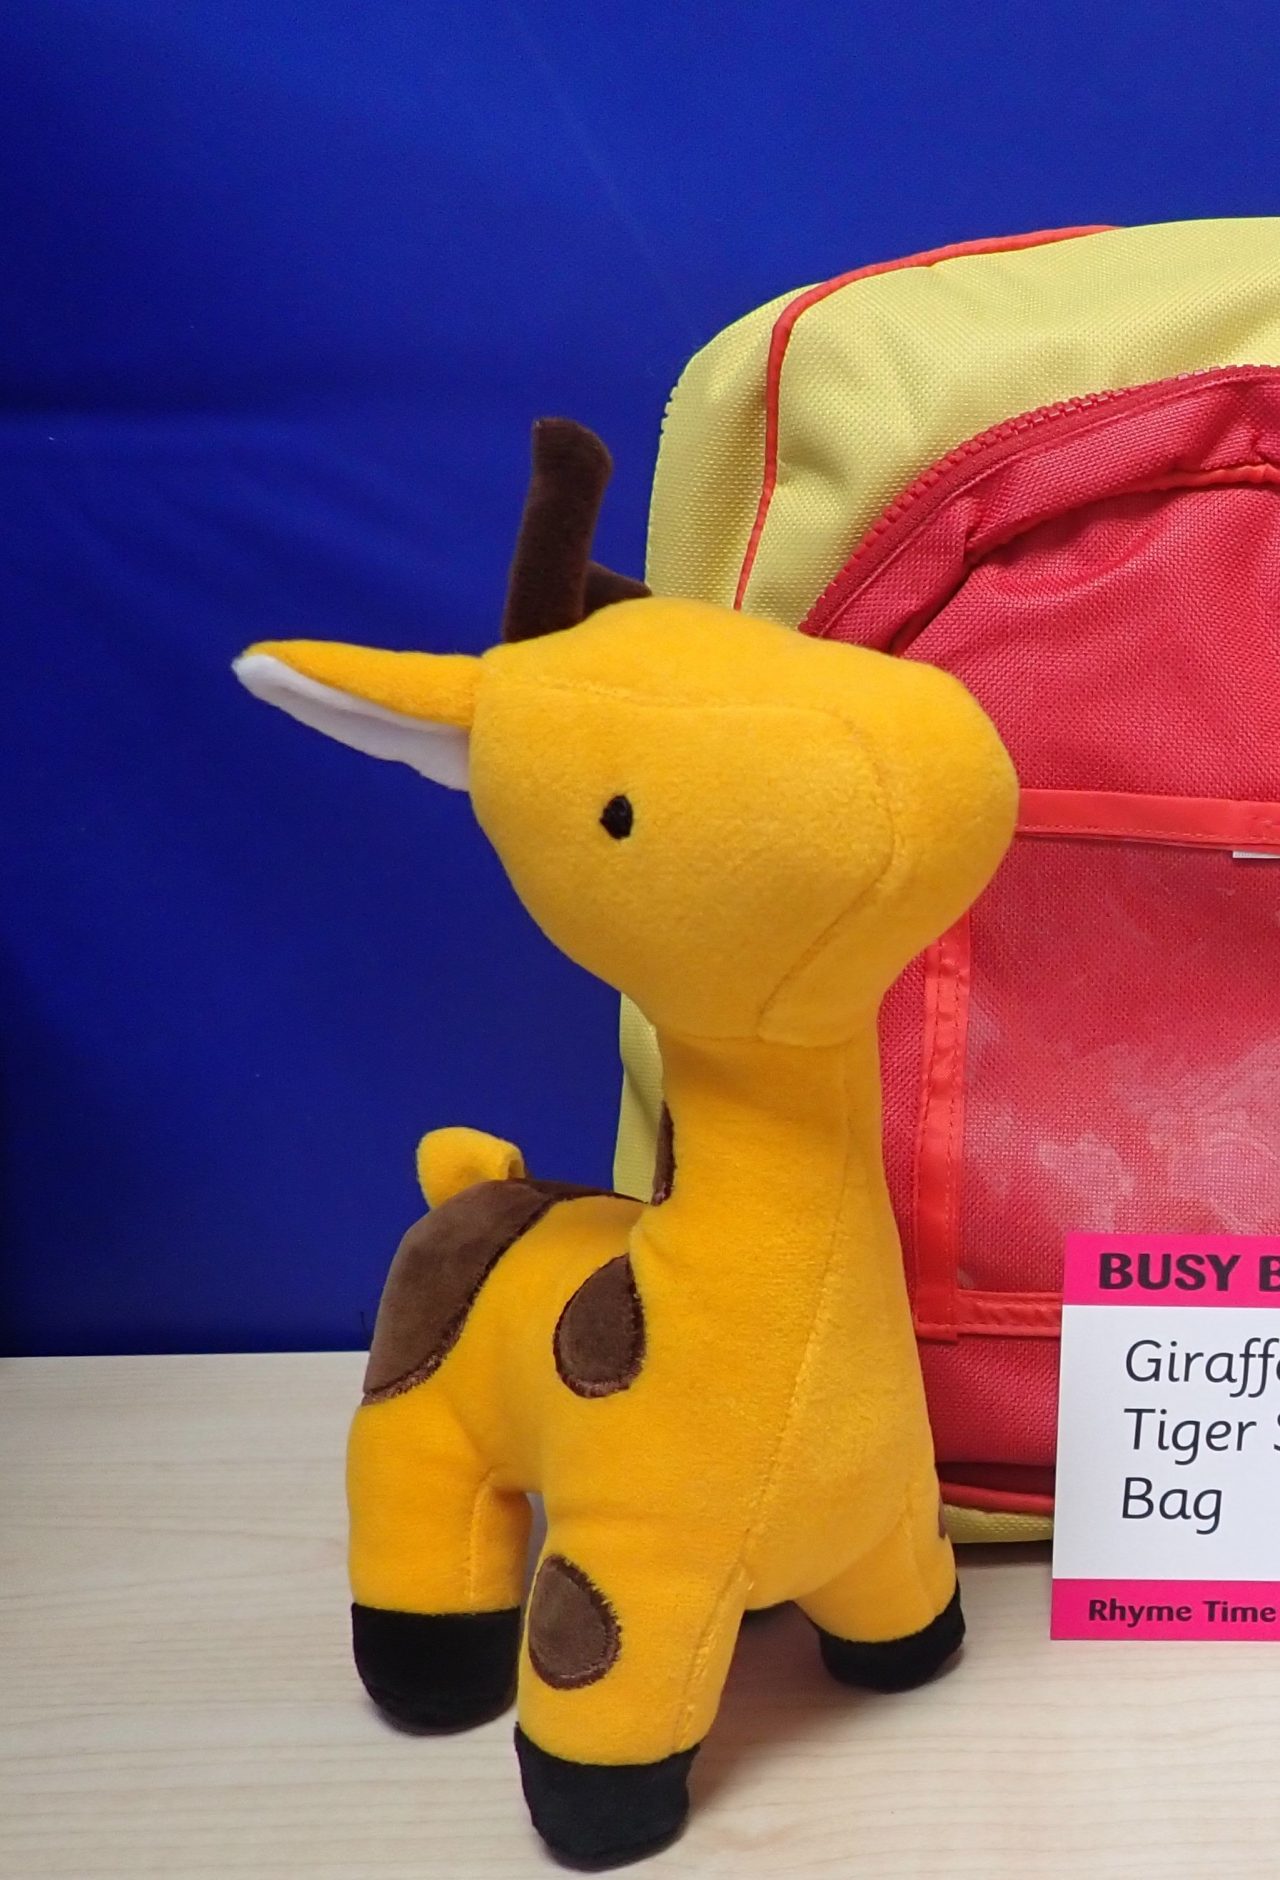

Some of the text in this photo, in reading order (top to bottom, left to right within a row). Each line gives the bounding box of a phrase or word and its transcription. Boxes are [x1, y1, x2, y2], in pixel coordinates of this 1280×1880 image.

[1099, 1253, 1240, 1291] BUSY
[1124, 1408, 1257, 1466] Tiger
[1121, 1477, 1223, 1534] Bag
[1088, 1599, 1192, 1627] Rhyme
[1204, 1601, 1276, 1623] Time
